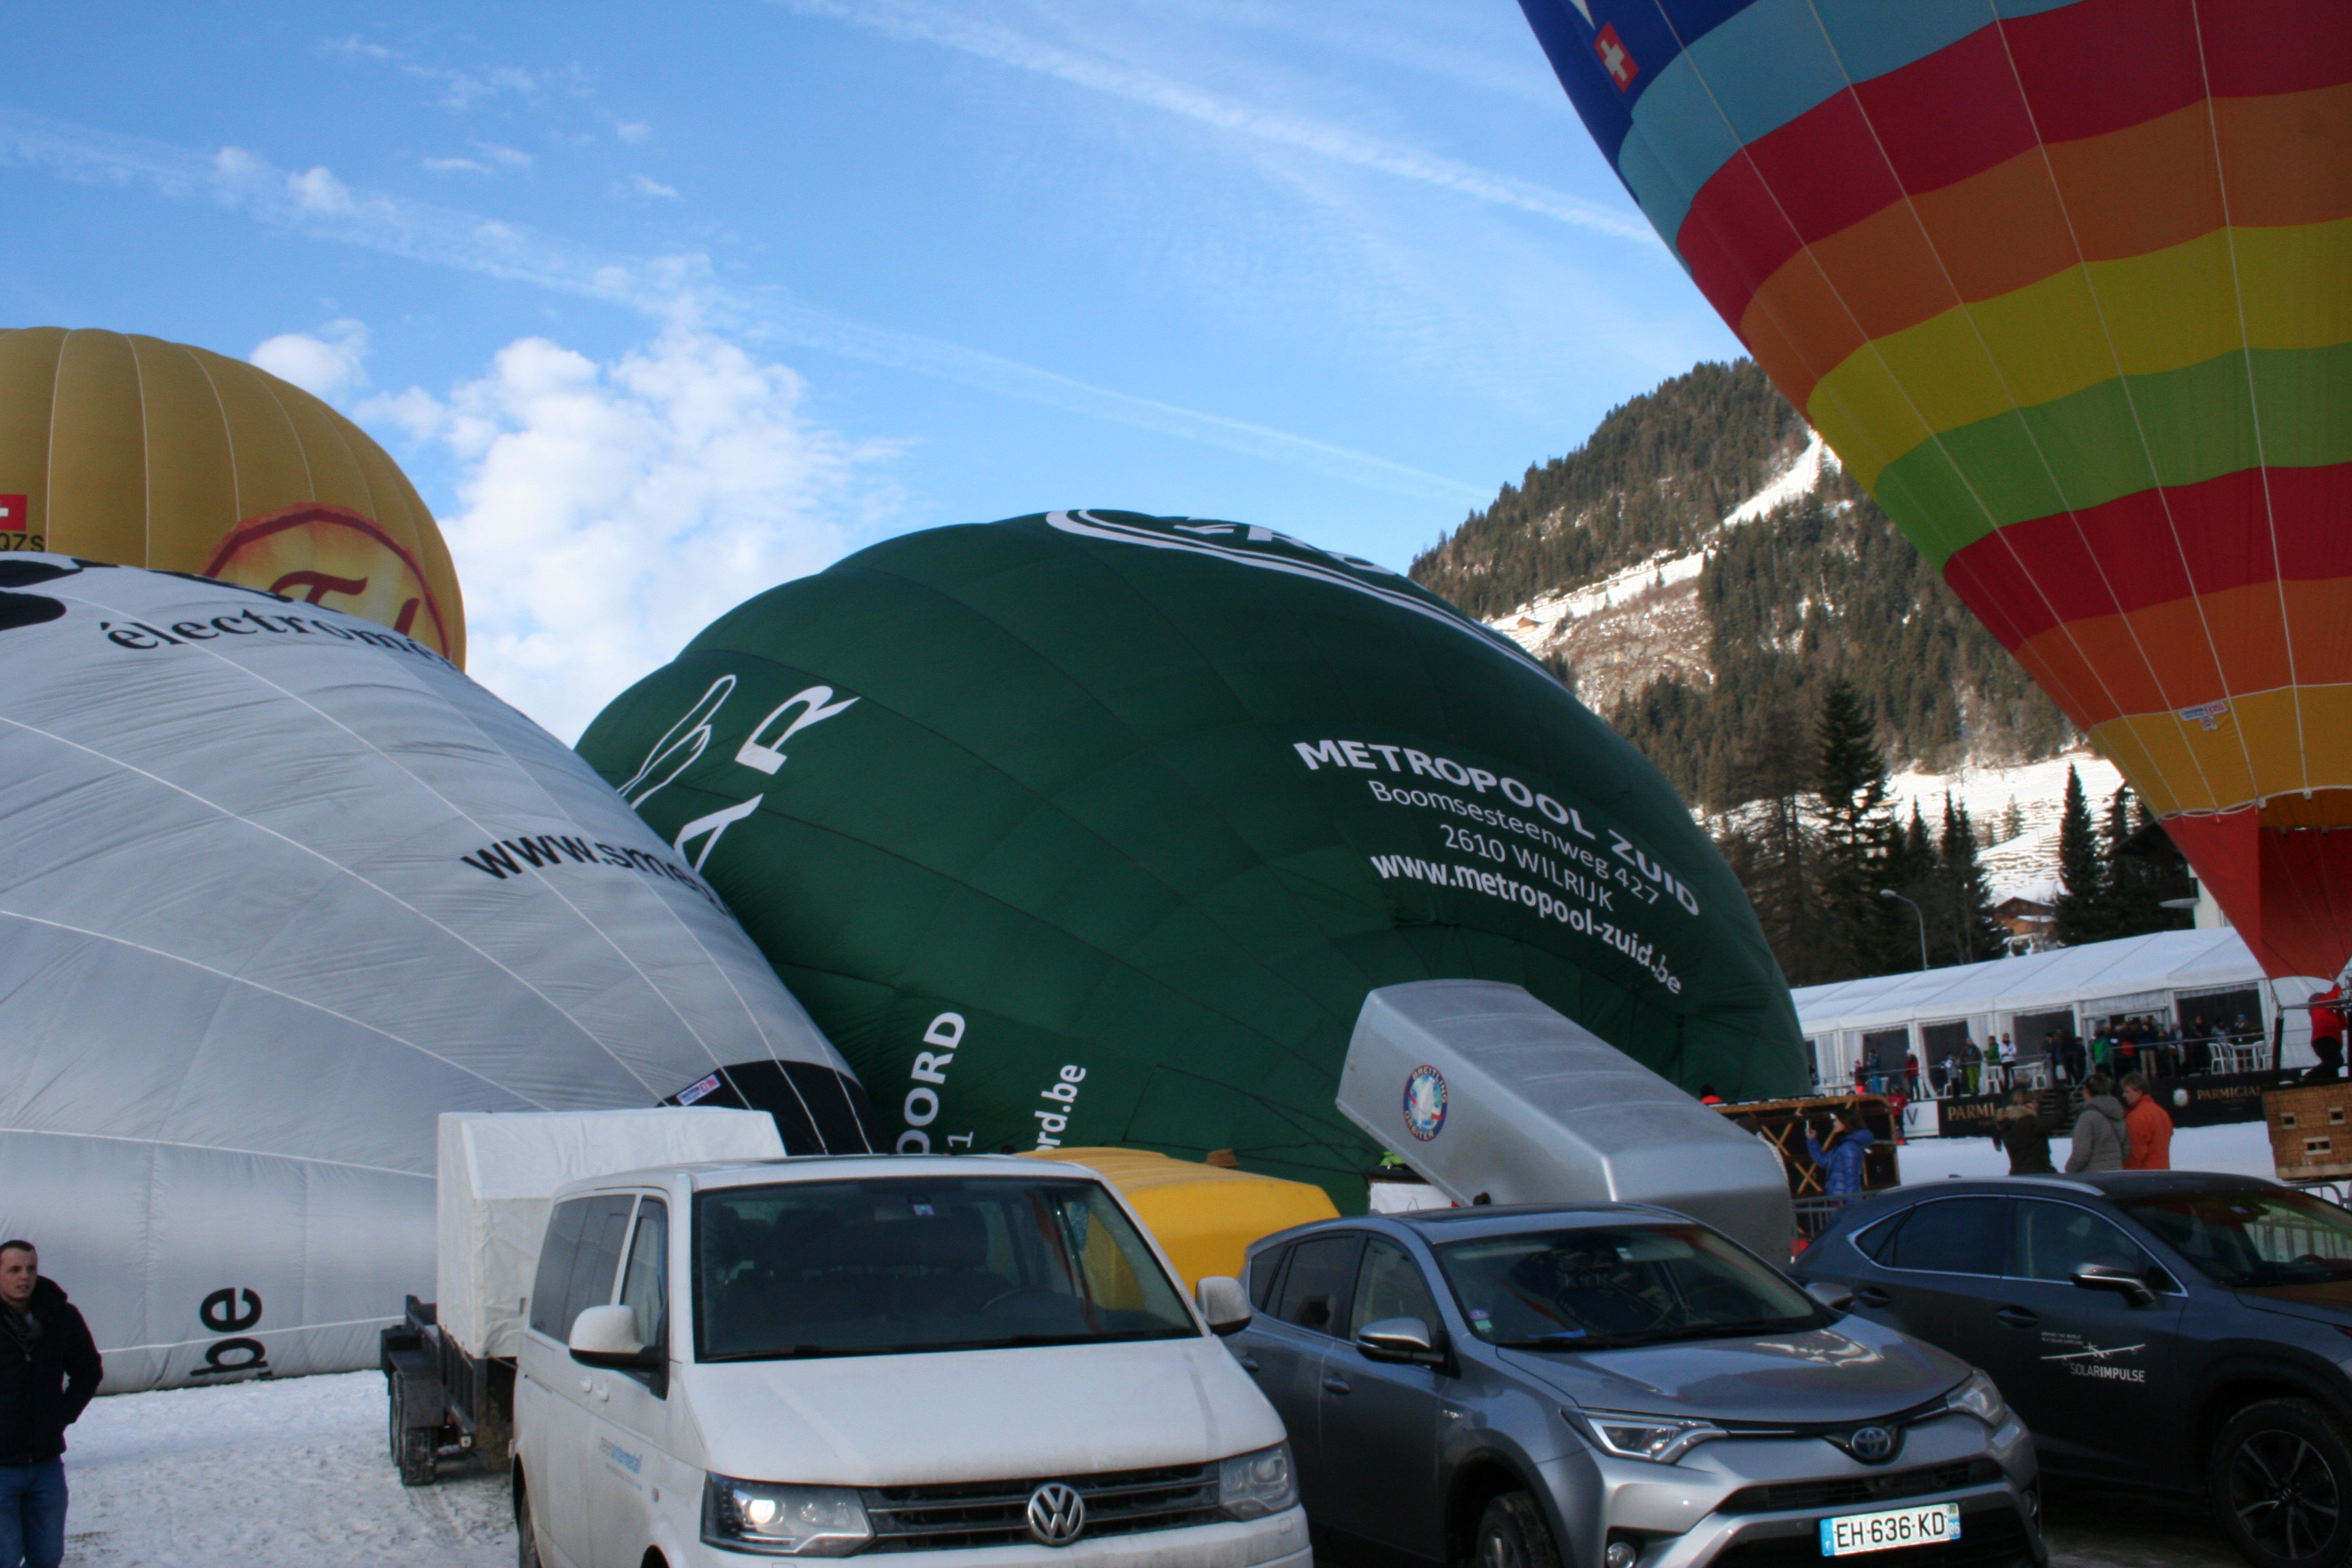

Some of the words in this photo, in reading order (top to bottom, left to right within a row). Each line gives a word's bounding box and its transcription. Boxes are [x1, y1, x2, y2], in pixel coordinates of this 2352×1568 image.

[1294, 739, 1596, 840] METROPOOL
[1608, 828, 1700, 916] ZUID
[1368, 780, 1610, 879] Boomsesteenweg
[1614, 868, 1660, 904] 427
[1439, 823, 1506, 862] 2610
[1512, 844, 1614, 911] WILRIJK
[1370, 854, 1682, 995] www.metropool-zuid.be
